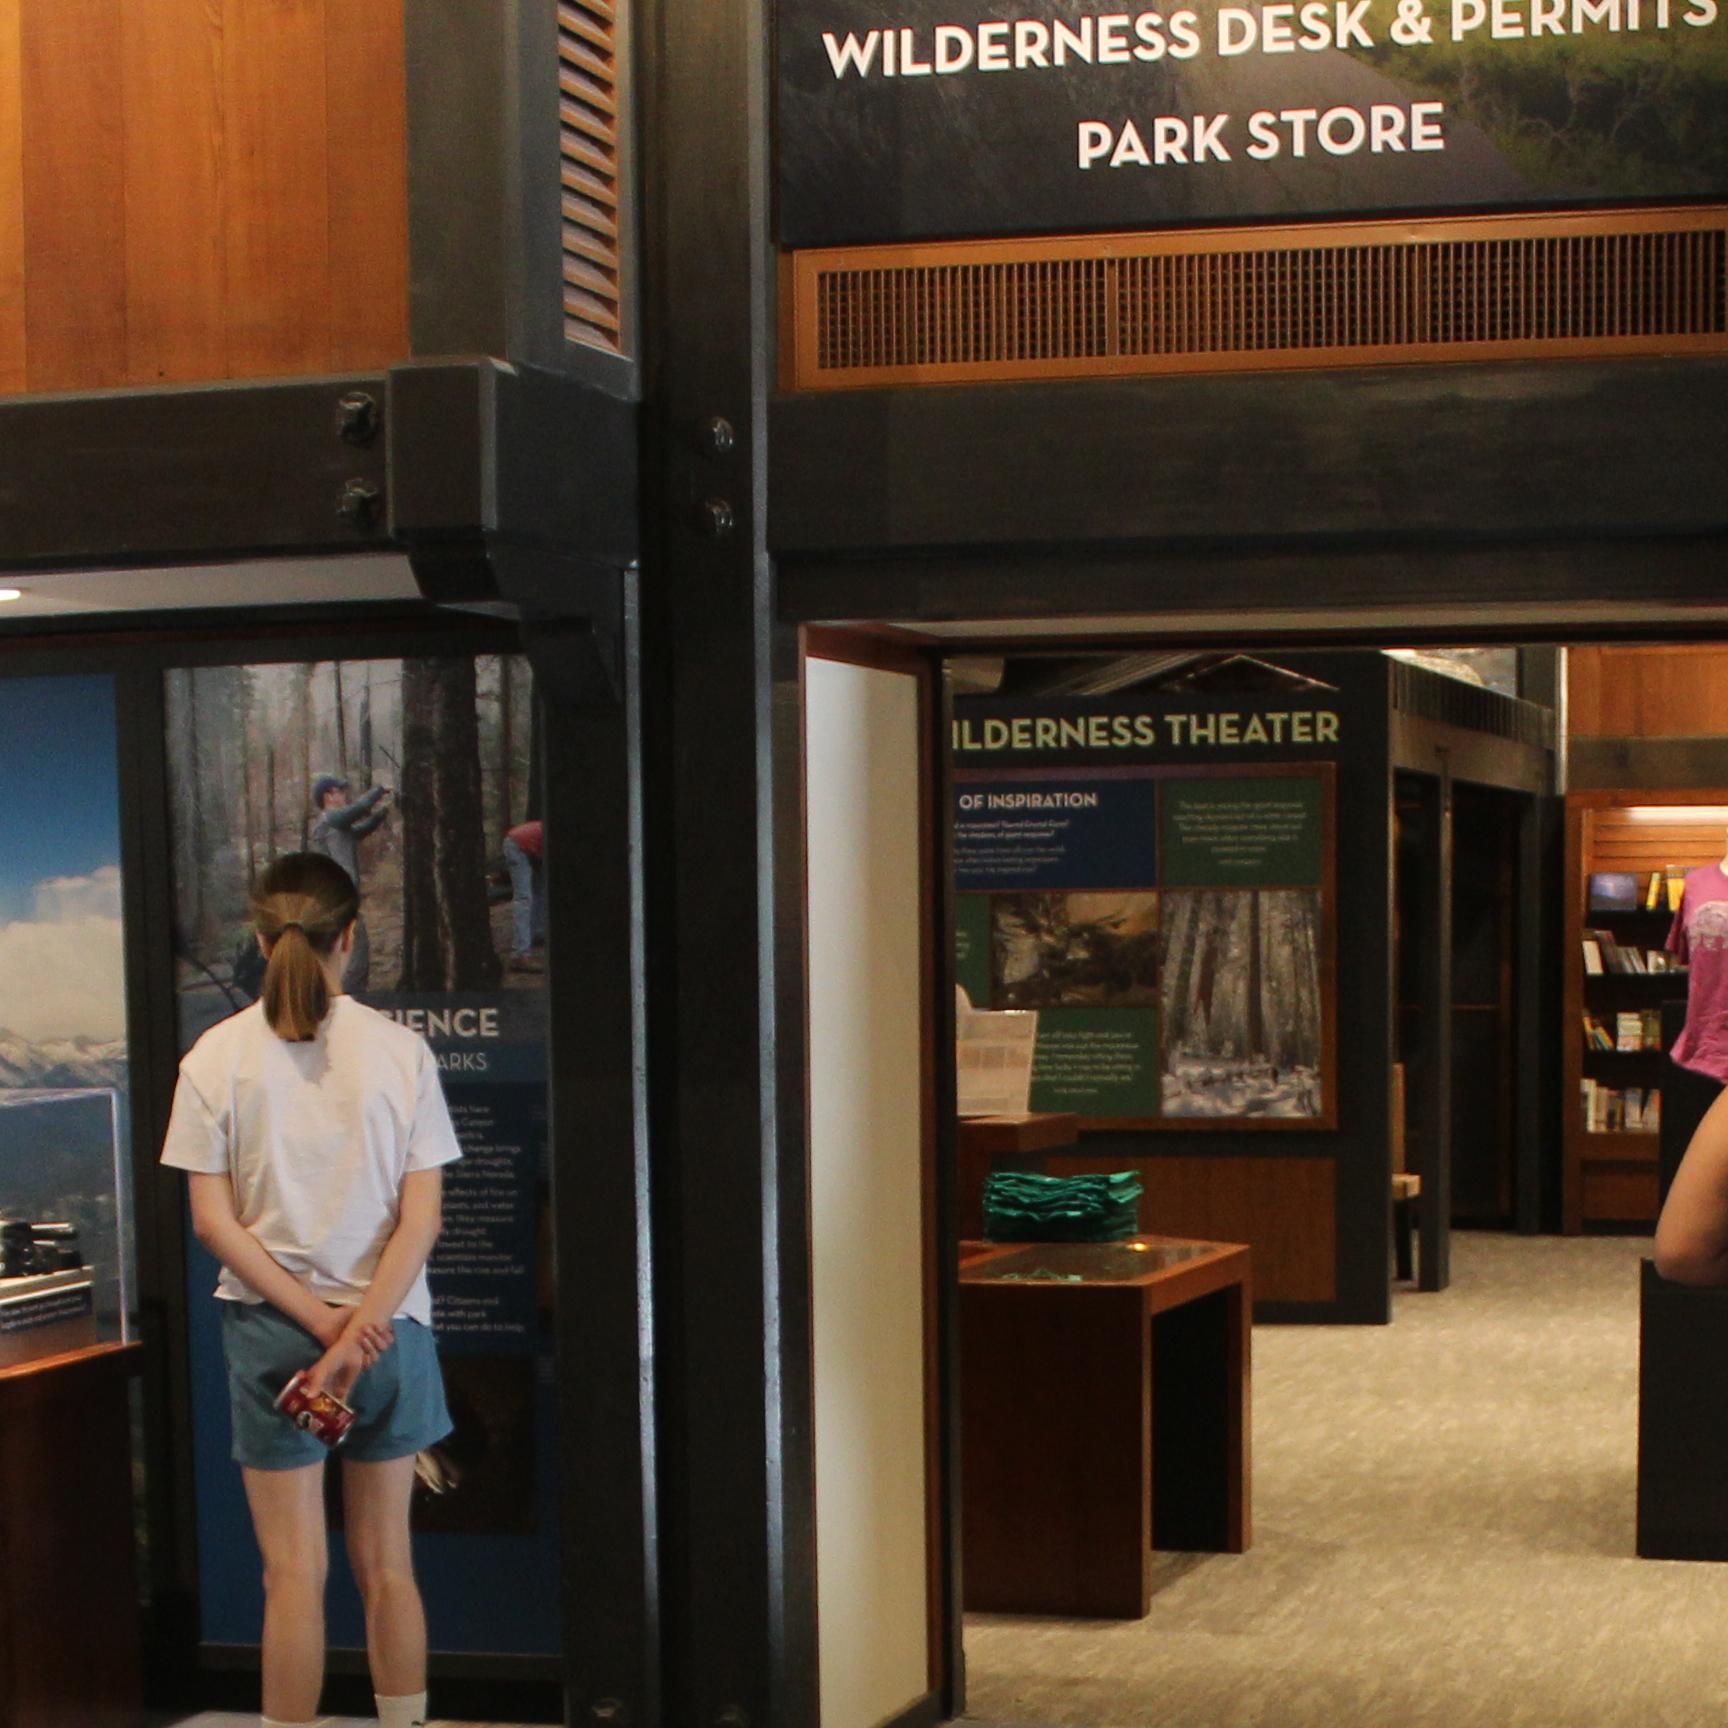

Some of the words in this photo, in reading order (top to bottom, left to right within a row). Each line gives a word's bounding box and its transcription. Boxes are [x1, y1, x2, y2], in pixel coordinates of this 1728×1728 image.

[822, 9, 1201, 80] WILDERNESS
[1215, 0, 1376, 58] DESK
[1390, 0, 1433, 46] &
[1451, 0, 1718, 42] PERMITS
[1077, 114, 1232, 171] PARK
[1245, 101, 1446, 160] STORE
[952, 715, 1155, 750] ILDERNESS
[1164, 711, 1340, 745] THEATER
[959, 794, 983, 810] OF
[988, 792, 1098, 809] INSPIRATION
[378, 1008, 499, 1038] IENCE
[437, 1052, 488, 1070] ARKS
